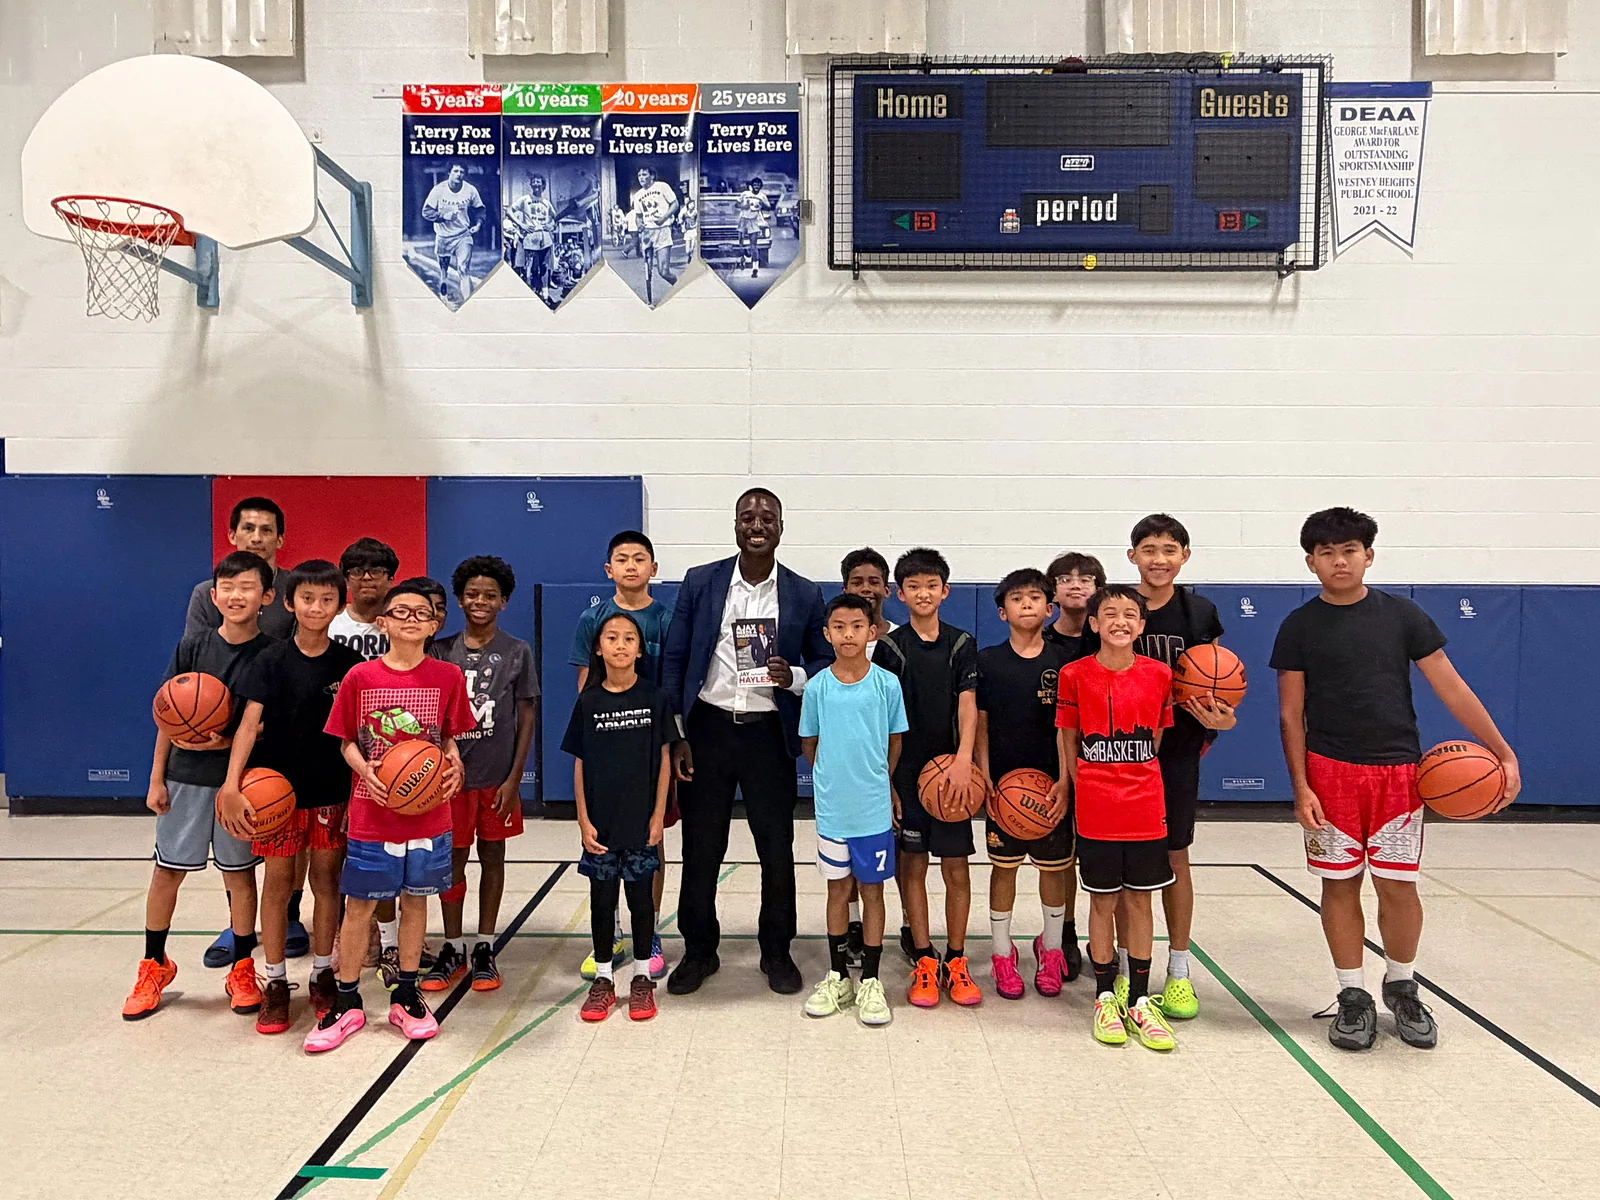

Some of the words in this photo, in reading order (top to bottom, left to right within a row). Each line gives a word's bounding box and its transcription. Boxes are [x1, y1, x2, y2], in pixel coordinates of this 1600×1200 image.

[420, 93, 432, 108] 5
[435, 93, 485, 111] years
[516, 92, 536, 107] 10
[539, 92, 589, 111] years
[615, 91, 635, 106] 20
[638, 92, 689, 109] years
[712, 90, 733, 106] 25
[736, 91, 786, 109] years
[877, 87, 947, 119] Home
[1200, 88, 1289, 118] Guests
[1340, 107, 1416, 121] DEAA
[414, 125, 461, 141] Terry
[462, 125, 491, 138] Fox
[513, 125, 558, 141] Terry
[561, 125, 591, 138] Fox
[612, 123, 657, 139] Terry
[661, 124, 690, 137] Fox
[710, 123, 755, 138] Terry
[757, 122, 787, 136] Fox
[1334, 126, 1368, 136] GEORGE
[1369, 126, 1419, 136] MacFARLANE
[410, 141, 454, 155] Lives
[457, 141, 495, 155] Here
[510, 141, 554, 155] Lives
[557, 141, 595, 155] Here
[609, 140, 653, 154] Lives
[656, 140, 694, 154] Here
[707, 140, 751, 154] Lives
[754, 139, 793, 152] Here
[1353, 138, 1382, 147] AWARD
[1384, 138, 1400, 147] FOR
[1344, 150, 1408, 159] OUTSTANDING
[1339, 161, 1414, 171] SPORTSMANSHIP
[1337, 178, 1377, 187] WESTNEY
[1379, 178, 1415, 187] HEIGHTS
[1341, 189, 1375, 199] PUBLIC
[1377, 189, 1414, 199] SCHOOL
[1037, 193, 1118, 226] period
[1353, 206, 1376, 215] 2021
[1386, 206, 1397, 215] 22
[740, 674, 772, 683] HAYLES
[395, 757, 436, 798] Wilson
[1020, 793, 1052, 821] Wils
[875, 849, 887, 872] 7
